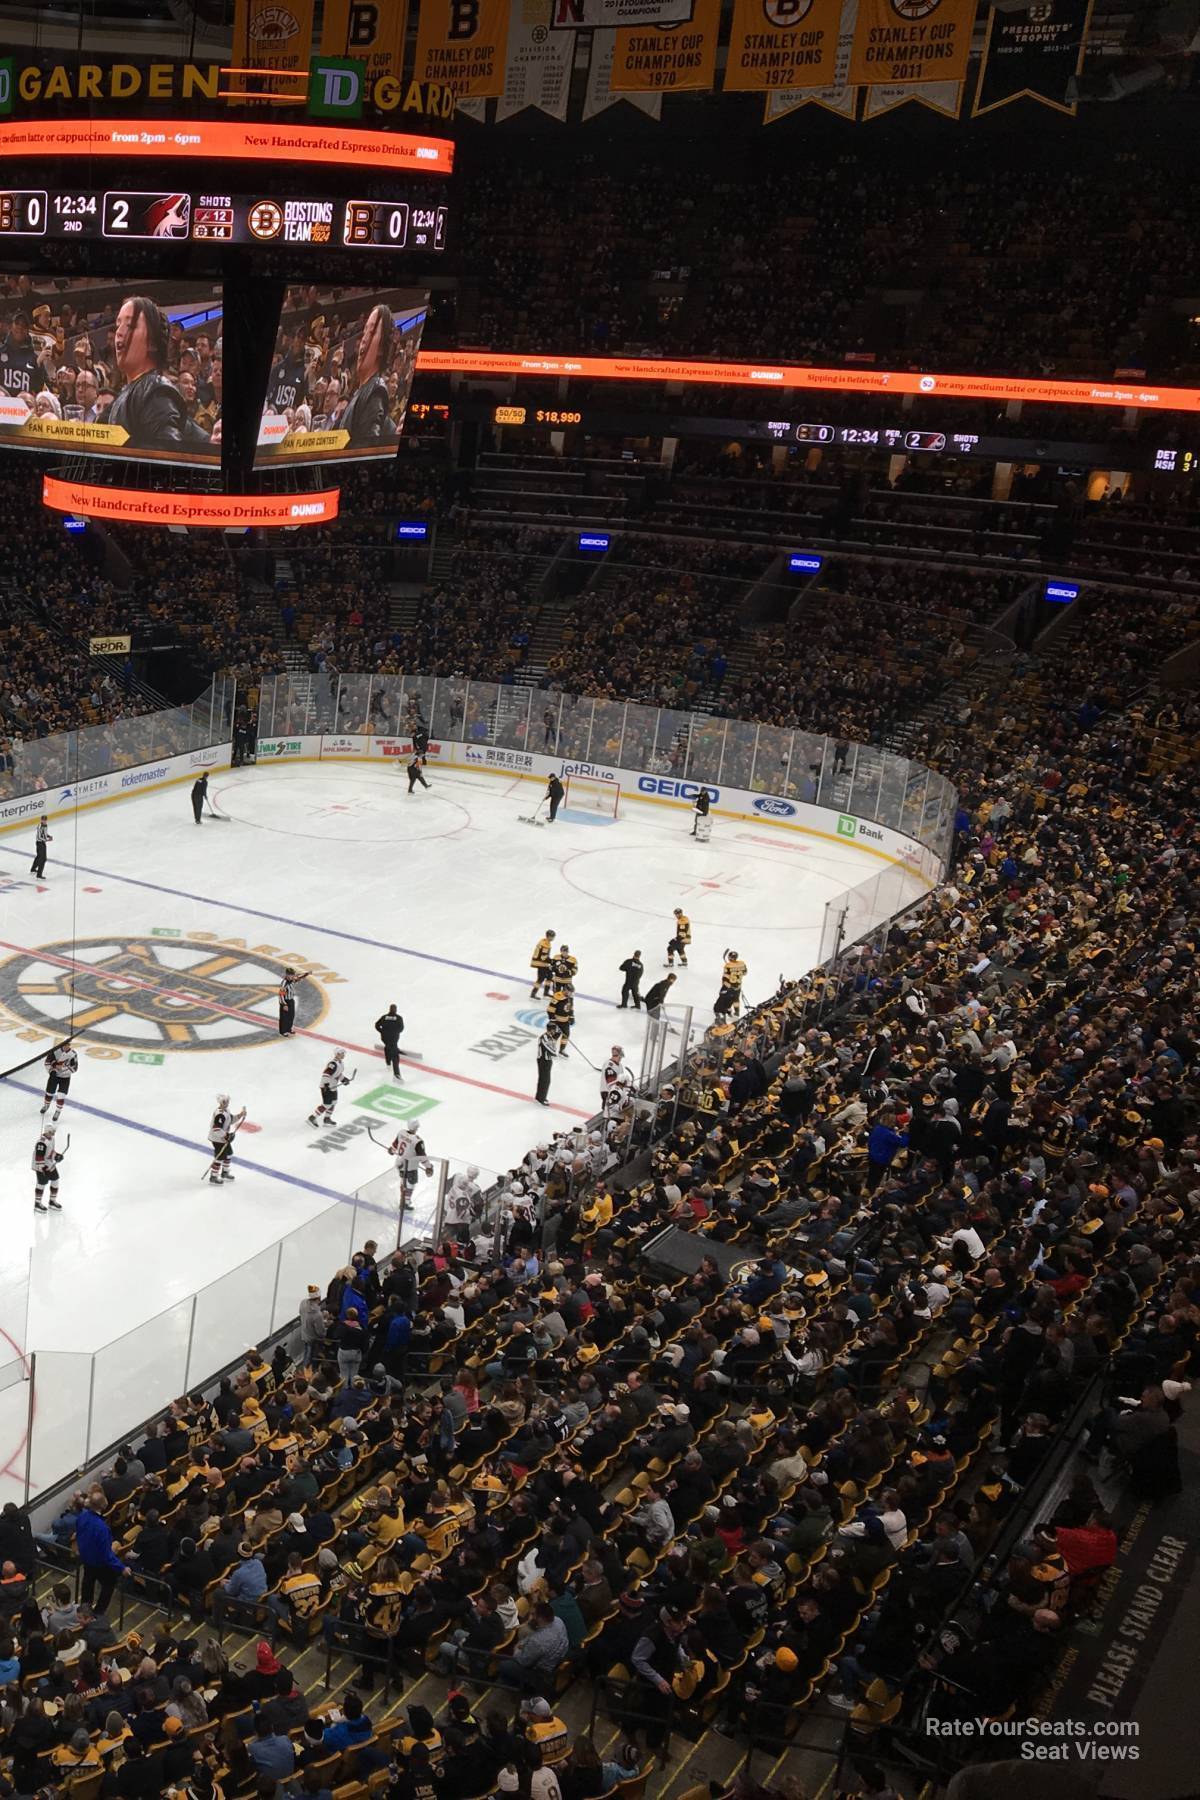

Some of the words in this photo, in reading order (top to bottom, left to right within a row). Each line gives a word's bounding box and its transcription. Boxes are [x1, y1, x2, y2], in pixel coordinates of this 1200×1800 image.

[248, 7, 301, 40] BOSTON
[743, 34, 802, 50] STANLEY
[802, 31, 824, 46] CUP
[868, 27, 928, 43] STANLEY
[931, 24, 956, 40] CUP
[1015, 32, 1058, 42] TROPHY
[628, 36, 678, 52] STANLEY
[680, 35, 704, 50] CUP
[427, 48, 473, 63] STANLEY
[475, 46, 494, 60] CUP
[625, 52, 702, 70] CHAMPIONS
[740, 50, 822, 68] CHAMPIONS
[865, 44, 954, 62] CHAMPIONS
[425, 63, 494, 79] CHAMPIONS
[648, 71, 676, 86] 1970
[764, 69, 794, 84] 1972
[891, 64, 922, 80] 2011
[19, 64, 220, 101] GARDEN
[317, 68, 360, 106] TD
[56, 133, 110, 146] cappuccino
[111, 131, 139, 143] from
[140, 132, 166, 145] 2pm
[174, 132, 201, 146] 6pm
[244, 135, 269, 146] New
[272, 136, 340, 150] Handcrafted
[341, 140, 381, 154] Espresso
[382, 144, 409, 157] Drinks
[199, 196, 231, 207] SHOTS
[27, 198, 40, 226] 0
[53, 196, 97, 215] 12:34
[111, 200, 129, 228] 2
[213, 211, 226, 221] 12
[63, 220, 83, 232] 2ND
[212, 227, 225, 238] 14
[283, 221, 311, 241] TEAM
[389, 210, 401, 239] 0
[412, 209, 434, 228] 12:34
[311, 231, 331, 243] 1924
[3, 368, 31, 392] USA
[275, 384, 297, 406] USA
[498, 408, 524, 419] 50/50
[535, 409, 582, 424] $18,990
[28, 423, 44, 433] FAN
[46, 425, 74, 436] FLAVOR
[75, 427, 110, 439] CONTEST
[767, 421, 791, 431] SHOTS
[295, 437, 316, 448] FLAVOR
[315, 435, 339, 447] CONTEST
[818, 427, 828, 440] 0
[840, 428, 880, 445] 12:34
[910, 433, 921, 446] 2
[953, 433, 979, 444] SHOTS
[888, 438, 895, 446] 2
[959, 443, 971, 453] 12
[1155, 449, 1177, 461] DET
[70, 493, 91, 508] New
[91, 496, 170, 515] Handcrafted
[172, 503, 231, 519] Espresso
[233, 505, 278, 518] Drinks
[278, 506, 289, 517] at
[399, 526, 426, 534] GEICO
[580, 537, 608, 546] GEICO
[790, 558, 820, 568] GEICO
[1047, 587, 1077, 598] GEICO
[286, 741, 301, 751] TIRE
[190, 753, 201, 764] Red
[202, 750, 219, 761] River
[120, 766, 169, 788] ticketmaster
[72, 779, 109, 797] SYMETRA
[638, 776, 720, 804] GEICO
[760, 798, 790, 816] Ford
[858, 825, 884, 842] Bank
[467, 1024, 538, 1062] AT&T
[307, 1114, 388, 1154] Bank
[1087, 1640, 1139, 1709] PLEASE
[1118, 1583, 1165, 1643] STAND
[1146, 1533, 1189, 1585] CLEAR
